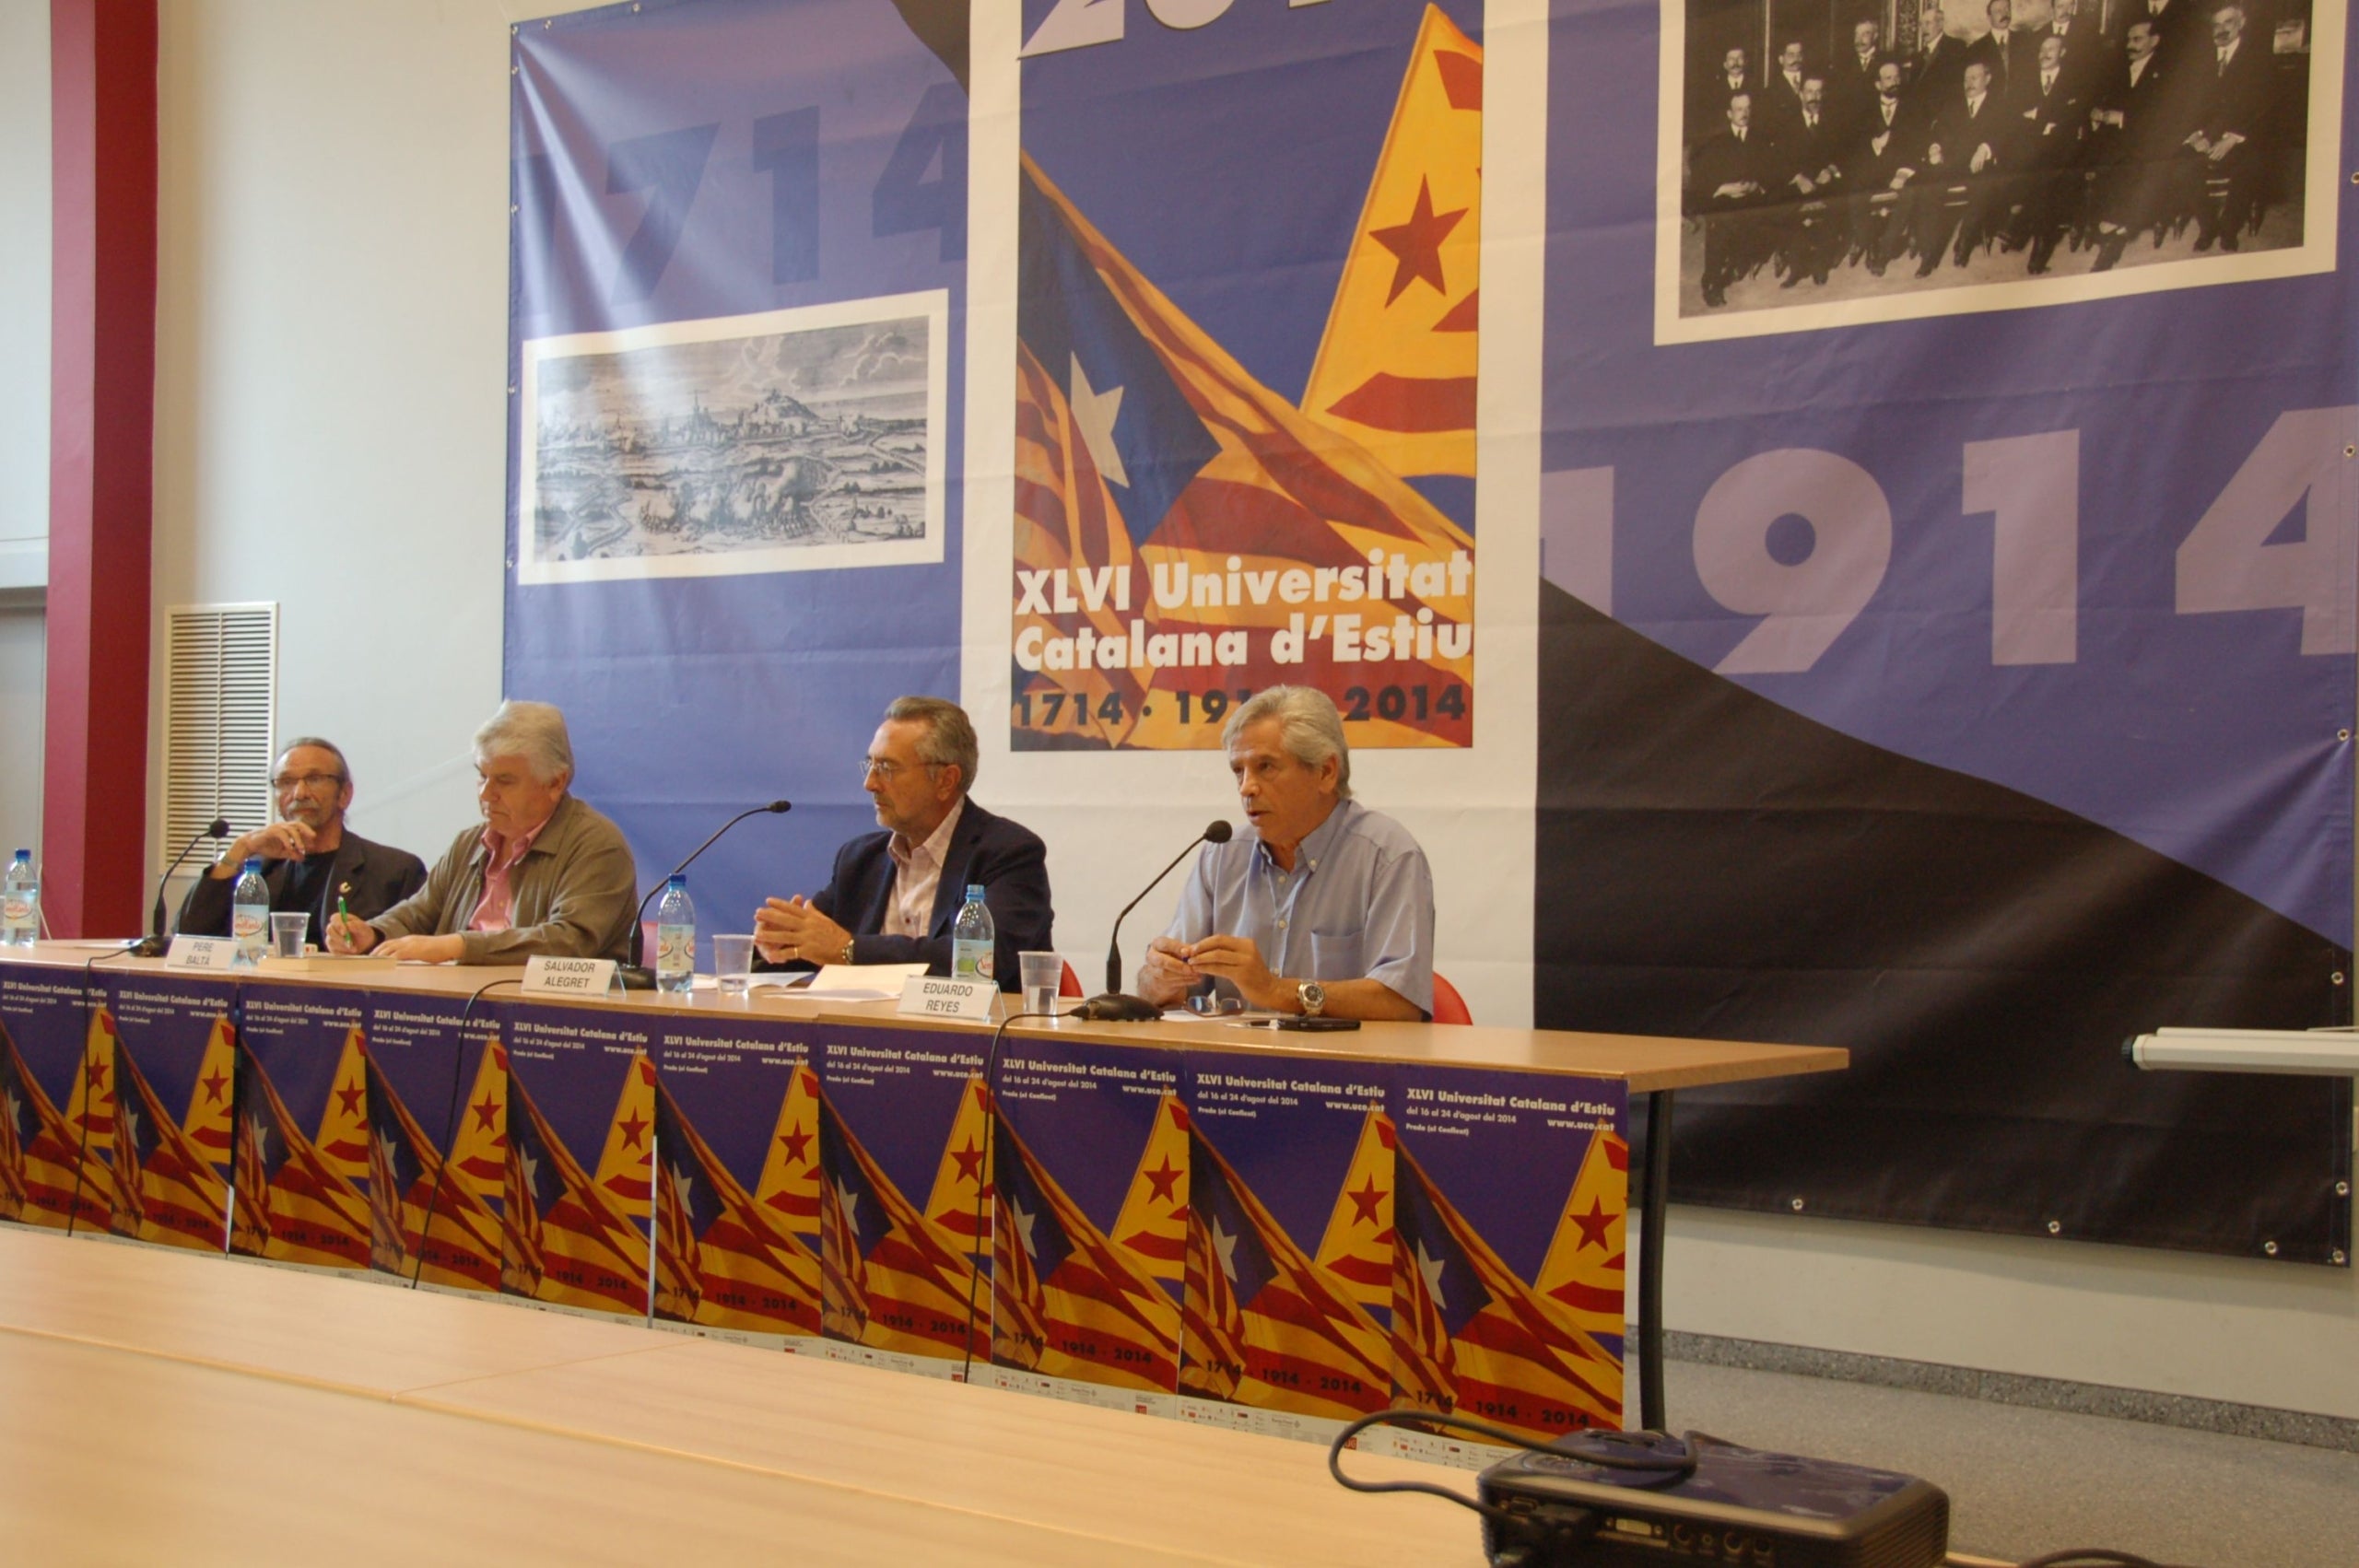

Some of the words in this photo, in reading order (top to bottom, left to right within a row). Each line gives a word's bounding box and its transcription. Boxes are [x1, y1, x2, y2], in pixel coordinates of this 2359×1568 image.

[1015, 565, 1131, 614] XLVI
[1153, 548, 1473, 609] Universitat
[1015, 619, 1248, 672] Catalana
[1270, 608, 1473, 664] d'Estiu
[1017, 691, 1123, 726] 1714
[1344, 685, 1466, 722] 2014
[544, 960, 595, 973] SALVADOR
[544, 976, 590, 988] ALEGRET
[922, 982, 973, 997] EDUARDO
[373, 1010, 391, 1020] XLVI
[393, 1012, 434, 1023] Universitat
[925, 1000, 960, 1013] REYES
[513, 1022, 532, 1032] XLVI
[534, 1024, 577, 1036] Universitat
[580, 1028, 616, 1040] Catalana
[663, 1036, 683, 1046] XLVI
[686, 1036, 733, 1048] Universitat
[735, 1039, 775, 1051] Catalana
[778, 1041, 808, 1053] d'Estiu
[827, 1045, 847, 1056] XLVI
[851, 1047, 901, 1059] Universitat
[904, 1050, 947, 1063] Catalana
[950, 1053, 983, 1065] d'Estiu
[1002, 1059, 1026, 1070] XLVI
[1028, 1060, 1086, 1074] Universitat
[1088, 1065, 1137, 1079] Catalana
[1140, 1069, 1178, 1082] d'Estiu
[1197, 1073, 1222, 1085] XLVI
[1226, 1076, 1286, 1090] Universitat
[1290, 1081, 1342, 1094] Catalana
[1345, 1083, 1385, 1097] d'Estiu
[1406, 1088, 1434, 1101] XLVI
[1438, 1091, 1506, 1106] Universitat
[1509, 1096, 1567, 1112] Catalana
[1570, 1101, 1615, 1116] d'Estiu
[1261, 1368, 1298, 1386] 1914
[1320, 1376, 1362, 1393] 2014
[1476, 1400, 1518, 1418] 1914
[1542, 1410, 1590, 1426] 2014
